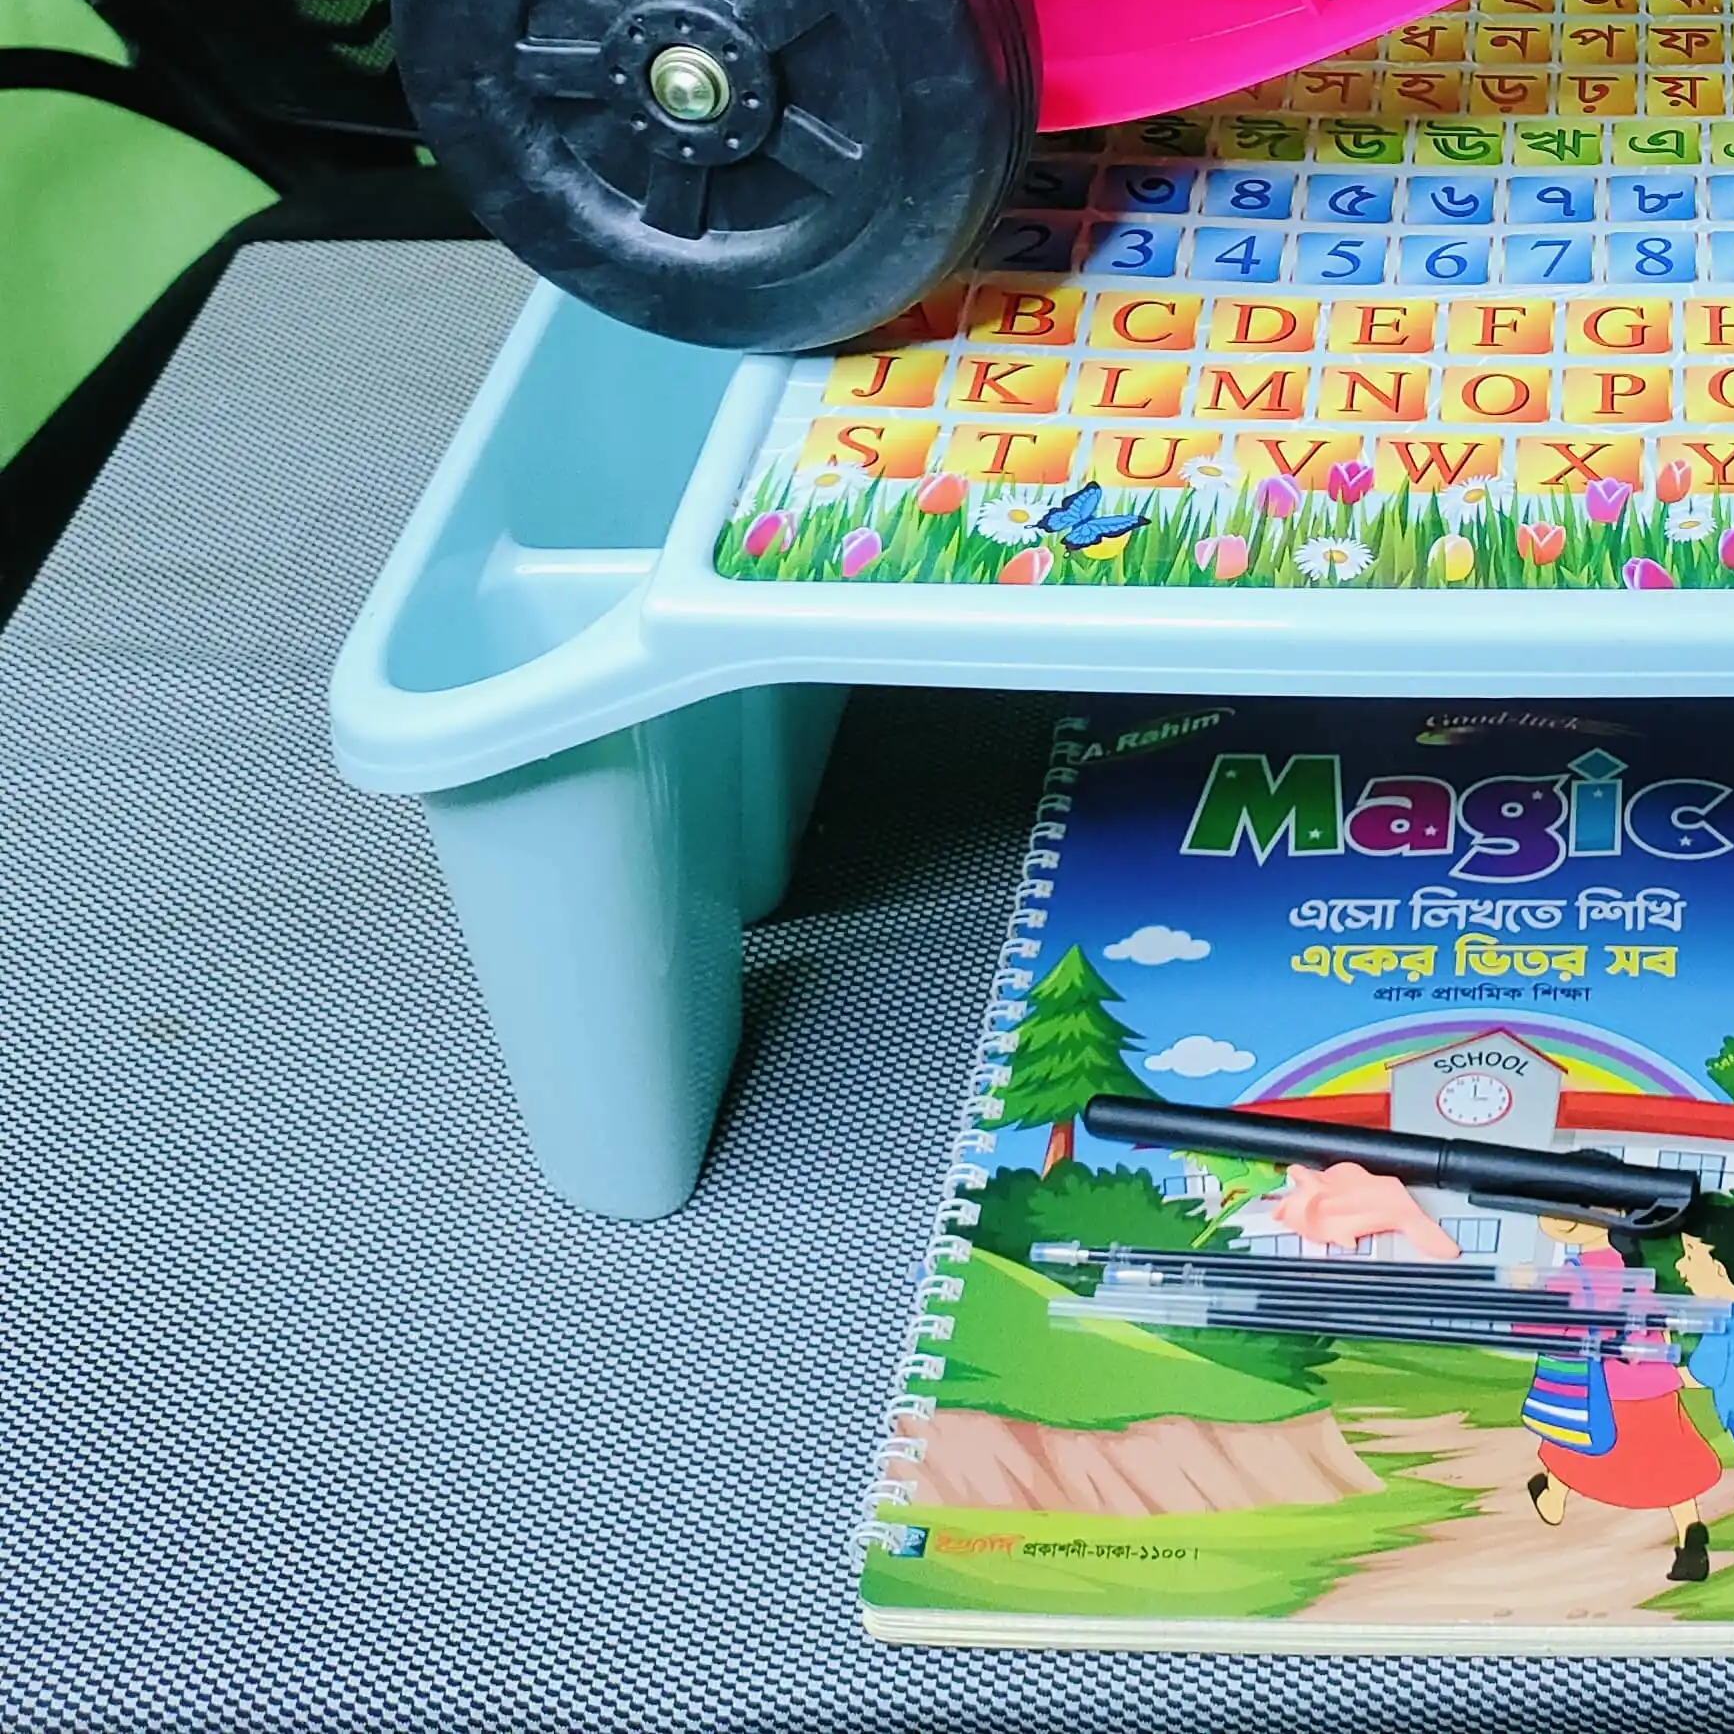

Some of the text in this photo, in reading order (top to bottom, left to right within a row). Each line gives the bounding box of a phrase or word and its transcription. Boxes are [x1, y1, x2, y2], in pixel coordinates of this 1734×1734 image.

[1400, 25, 1447, 56] ধ
[1483, 26, 1539, 57] ন
[1570, 24, 1627, 58] প
[1650, 28, 1712, 58] ফ
[1301, 70, 1362, 104] স
[1393, 73, 1445, 109] হ
[1474, 74, 1539, 112] ড়
[1566, 74, 1619, 113] ঢ়
[1653, 75, 1712, 109] য়
[1229, 116, 1299, 157] ঈ
[1326, 119, 1398, 159] উ
[1424, 121, 1499, 161] ঊ
[1520, 127, 1597, 162] ঋ
[1628, 129, 1685, 159] এ
[1126, 177, 1175, 204] ৩
[1230, 179, 1272, 210] ৪
[1329, 185, 1378, 217] ৫
[1430, 186, 1480, 218] ৬
[1535, 187, 1575, 216] ৭
[1634, 184, 1683, 213] ৮
[1002, 223, 1052, 263] 2
[1112, 229, 1154, 268] 3
[1215, 235, 1261, 274] 4
[1320, 241, 1364, 278] 5
[1424, 241, 1470, 279] 6
[1530, 240, 1572, 278] 7
[1634, 237, 1674, 276] 8
[992, 292, 1056, 336] B
[1112, 301, 1176, 344] C
[1226, 303, 1298, 345] D
[1352, 305, 1409, 346] E
[1471, 305, 1527, 347] F
[1582, 305, 1651, 348] G
[851, 355, 901, 397] J
[958, 360, 1034, 405] K
[1091, 365, 1154, 410] L
[1203, 370, 1298, 413] M
[1337, 371, 1413, 413] N
[1461, 373, 1530, 416] O
[1593, 373, 1647, 414] P
[827, 425, 885, 468] S
[977, 431, 1037, 474] T
[1115, 436, 1189, 480] U
[1257, 437, 1331, 478] V
[1389, 440, 1486, 484] W
[1540, 442, 1614, 485] X
[1115, 712, 1221, 753] Rahim
[1179, 747, 1734, 883] Magic
[1288, 886, 1687, 932] এসো লিখতে শিখি
[1290, 932, 1679, 984] একের ভিতর সব
[1373, 982, 1592, 1004] প্রাক প্রাথমিক শিক্ষা
[1432, 1050, 1529, 1077] SCHOOL
